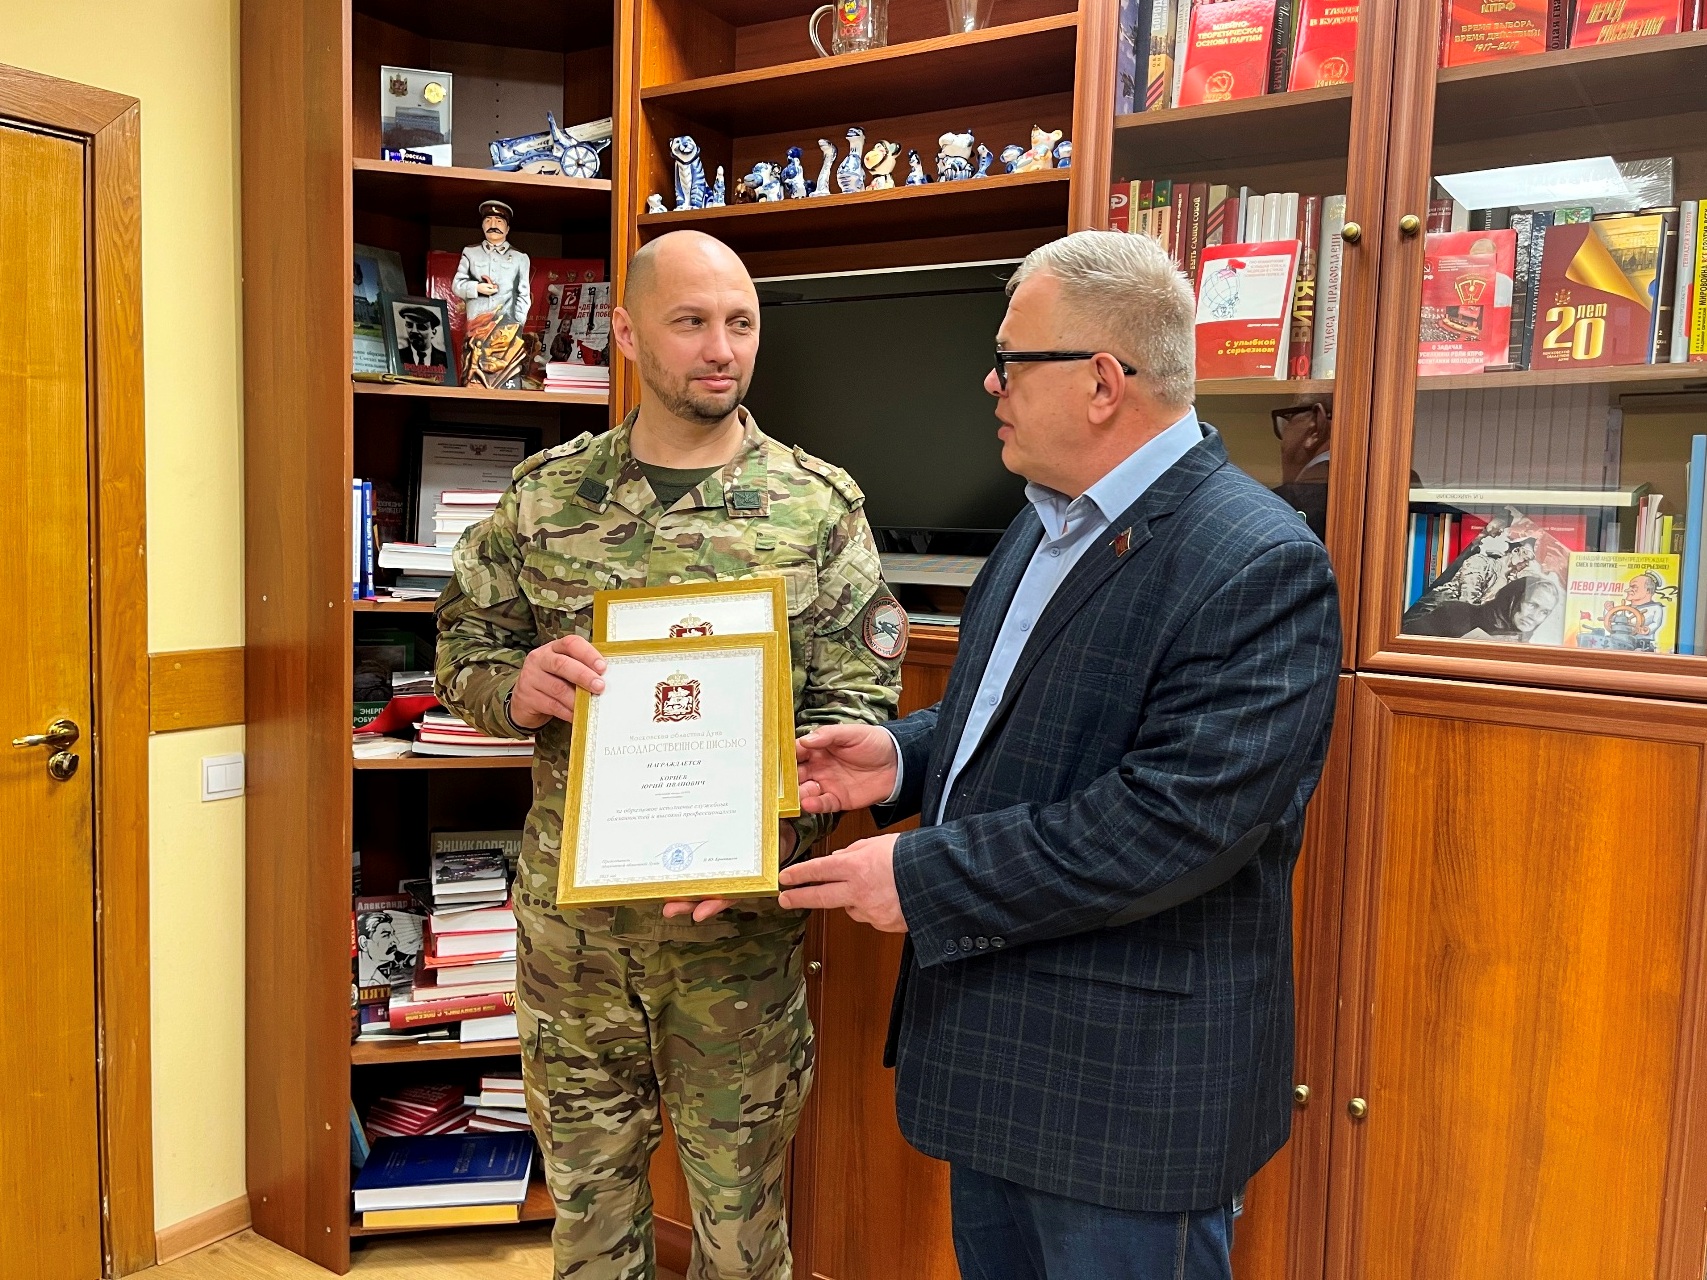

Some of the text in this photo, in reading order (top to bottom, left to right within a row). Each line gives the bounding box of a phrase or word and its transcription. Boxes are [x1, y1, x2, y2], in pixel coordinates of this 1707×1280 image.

[1481, 2, 1516, 13] КПРФ
[1310, 19, 1317, 27] В
[1461, 20, 1534, 32] ВРЕМЯ ВЫБОРА,
[1198, 26, 1263, 39] ТЕОРЕТИЧЕСКАЯ
[1454, 33, 1485, 42] ВРЕМЯ
[1195, 34, 1262, 48] ОСНОВА ПАРТИИ
[1273, 47, 1287, 90] Крыма
[1327, 233, 1340, 303] ПРАВОСЛАВИИ
[1577, 303, 1607, 318] лет
[1324, 316, 1335, 353] ЧУДЕСА
[1543, 306, 1605, 360] 20
[1233, 338, 1276, 348] улыбкой
[1226, 347, 1275, 356] серьезном
[1289, 355, 1309, 375] 10
[1570, 581, 1625, 593] ЛЕВО РУЛЯ!
[604, 738, 747, 756] БЛАГОДАРСТВЕННОЕ ПИСЬМО
[647, 760, 702, 769] НАГРАЖДАЕТСЯ
[436, 840, 521, 854] ЭНЦИКЛОПЕДИ
[358, 900, 407, 910] Александр
